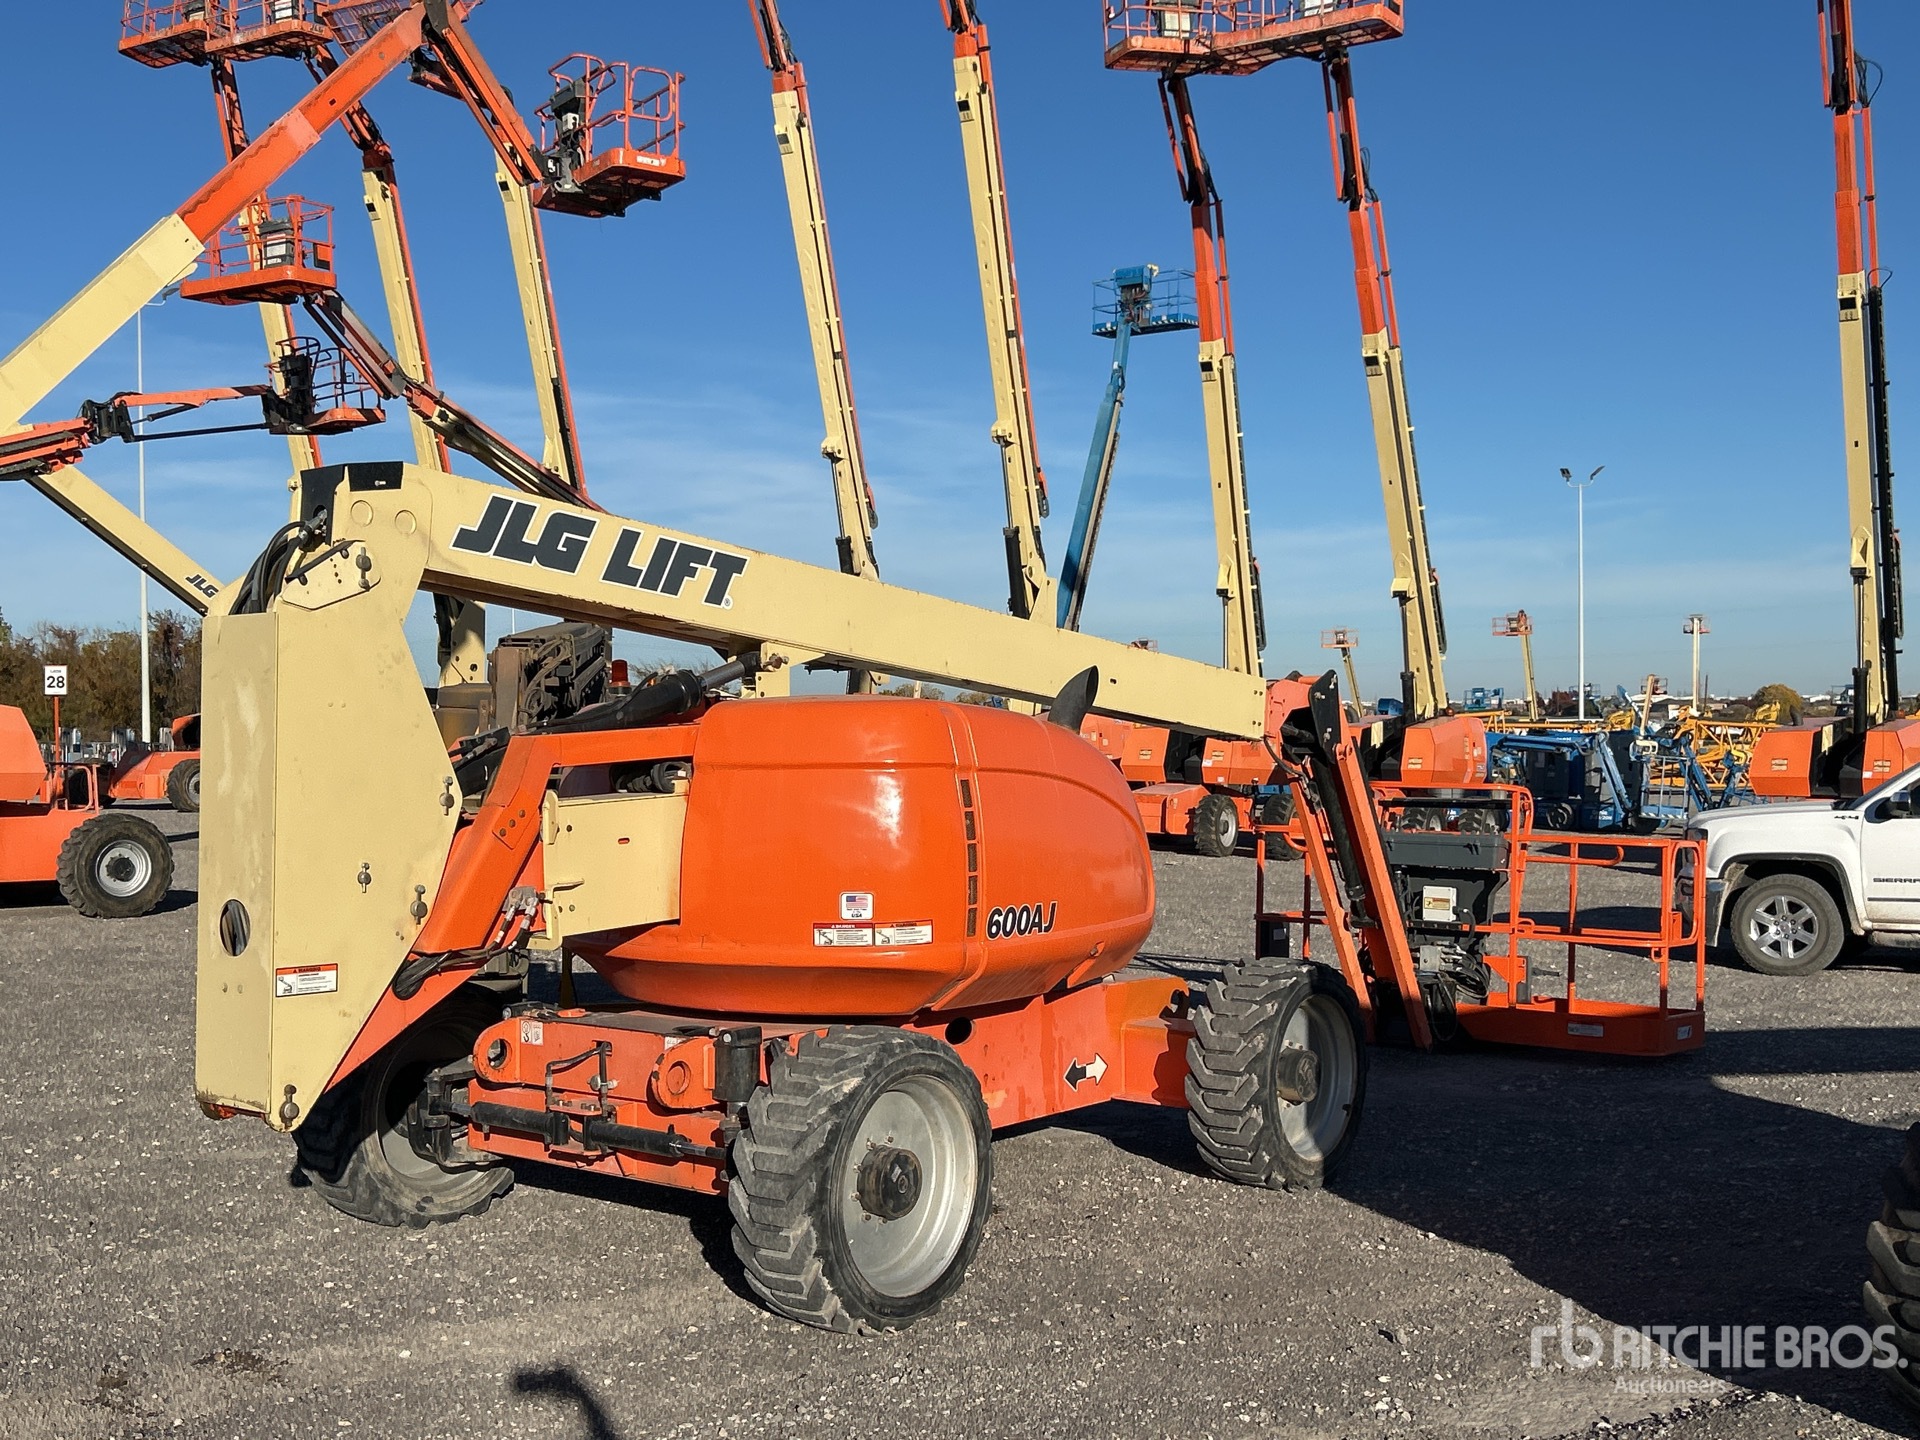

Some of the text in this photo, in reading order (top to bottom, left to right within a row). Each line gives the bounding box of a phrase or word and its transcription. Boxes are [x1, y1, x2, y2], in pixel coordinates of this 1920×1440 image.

[450, 494, 748, 606] JLG LIFT
[185, 573, 219, 599] JLG
[46, 675, 65, 689] 28
[986, 901, 1057, 940] 600AJ
